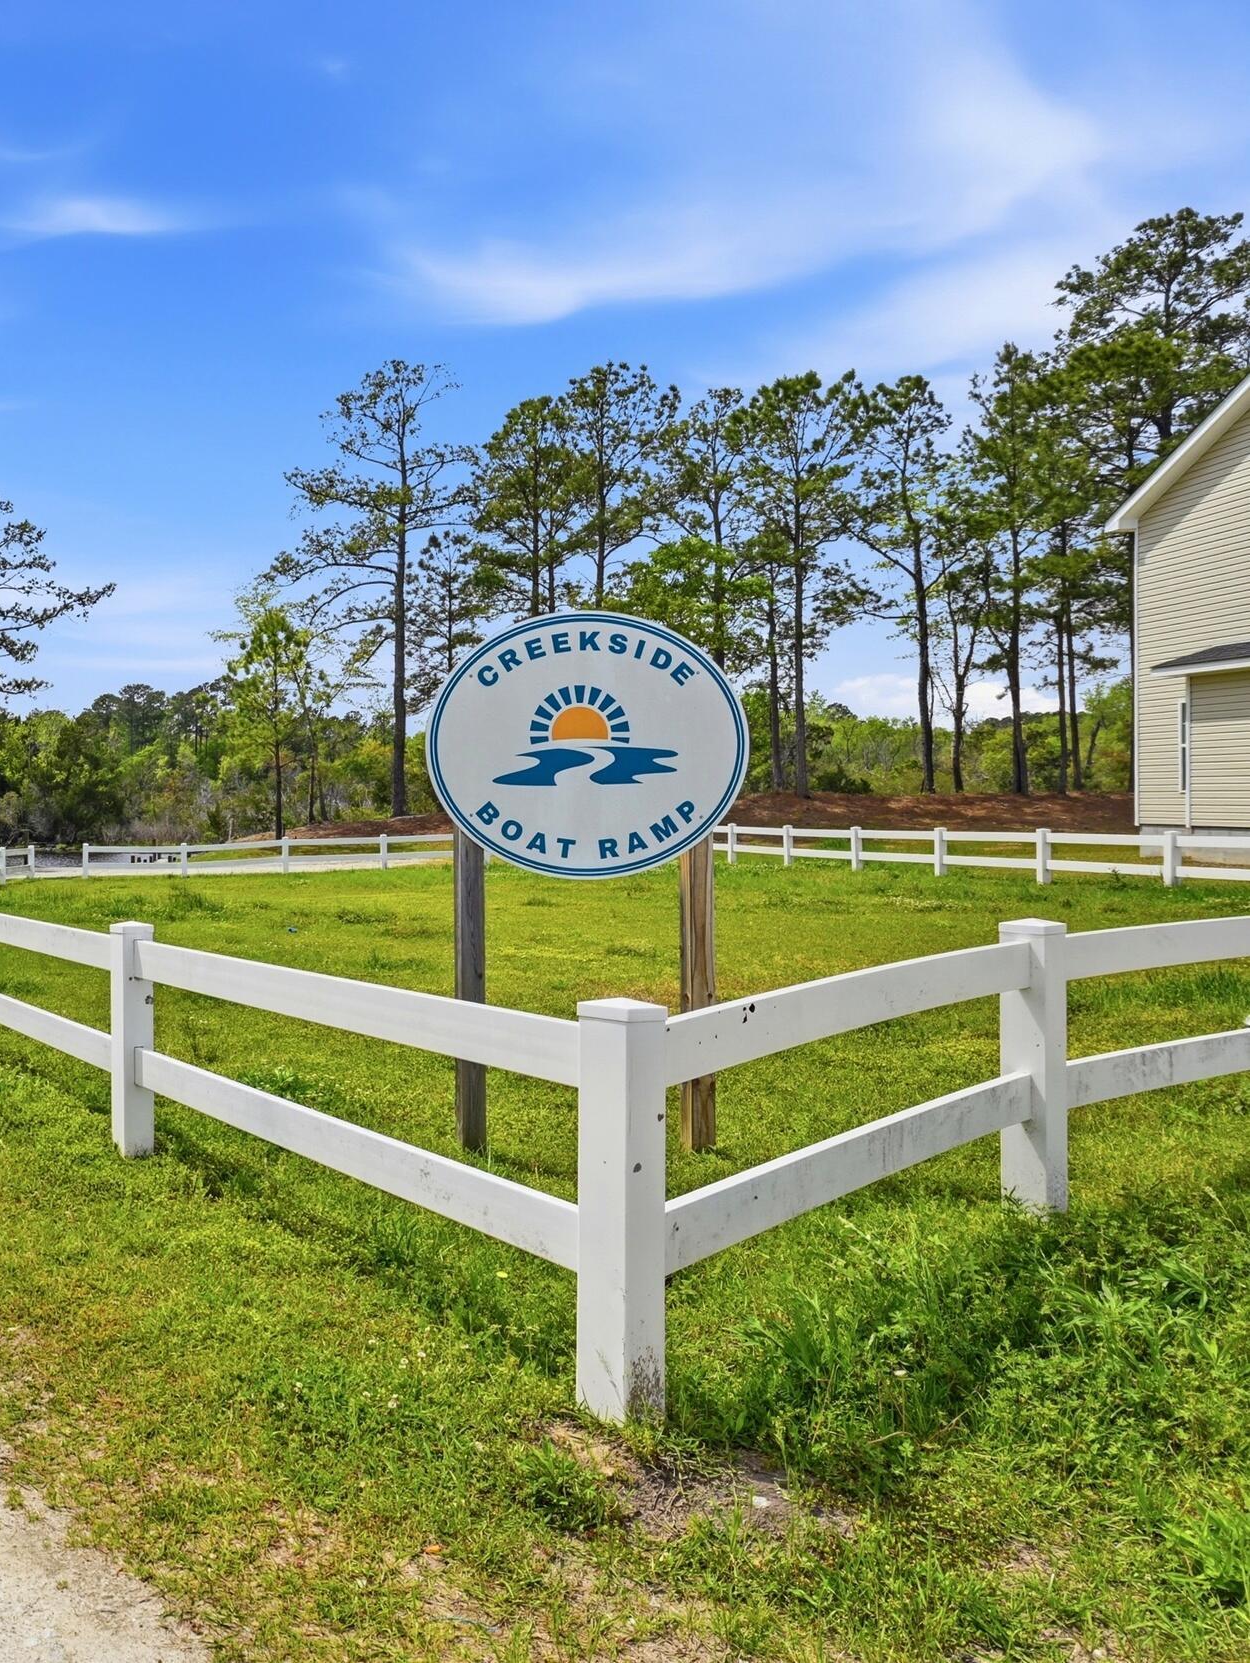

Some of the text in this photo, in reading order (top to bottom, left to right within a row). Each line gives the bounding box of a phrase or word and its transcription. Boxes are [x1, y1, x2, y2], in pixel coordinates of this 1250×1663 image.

[477, 631, 695, 687] CREEKSIDE
[475, 800, 695, 859] BOAT RAMP
